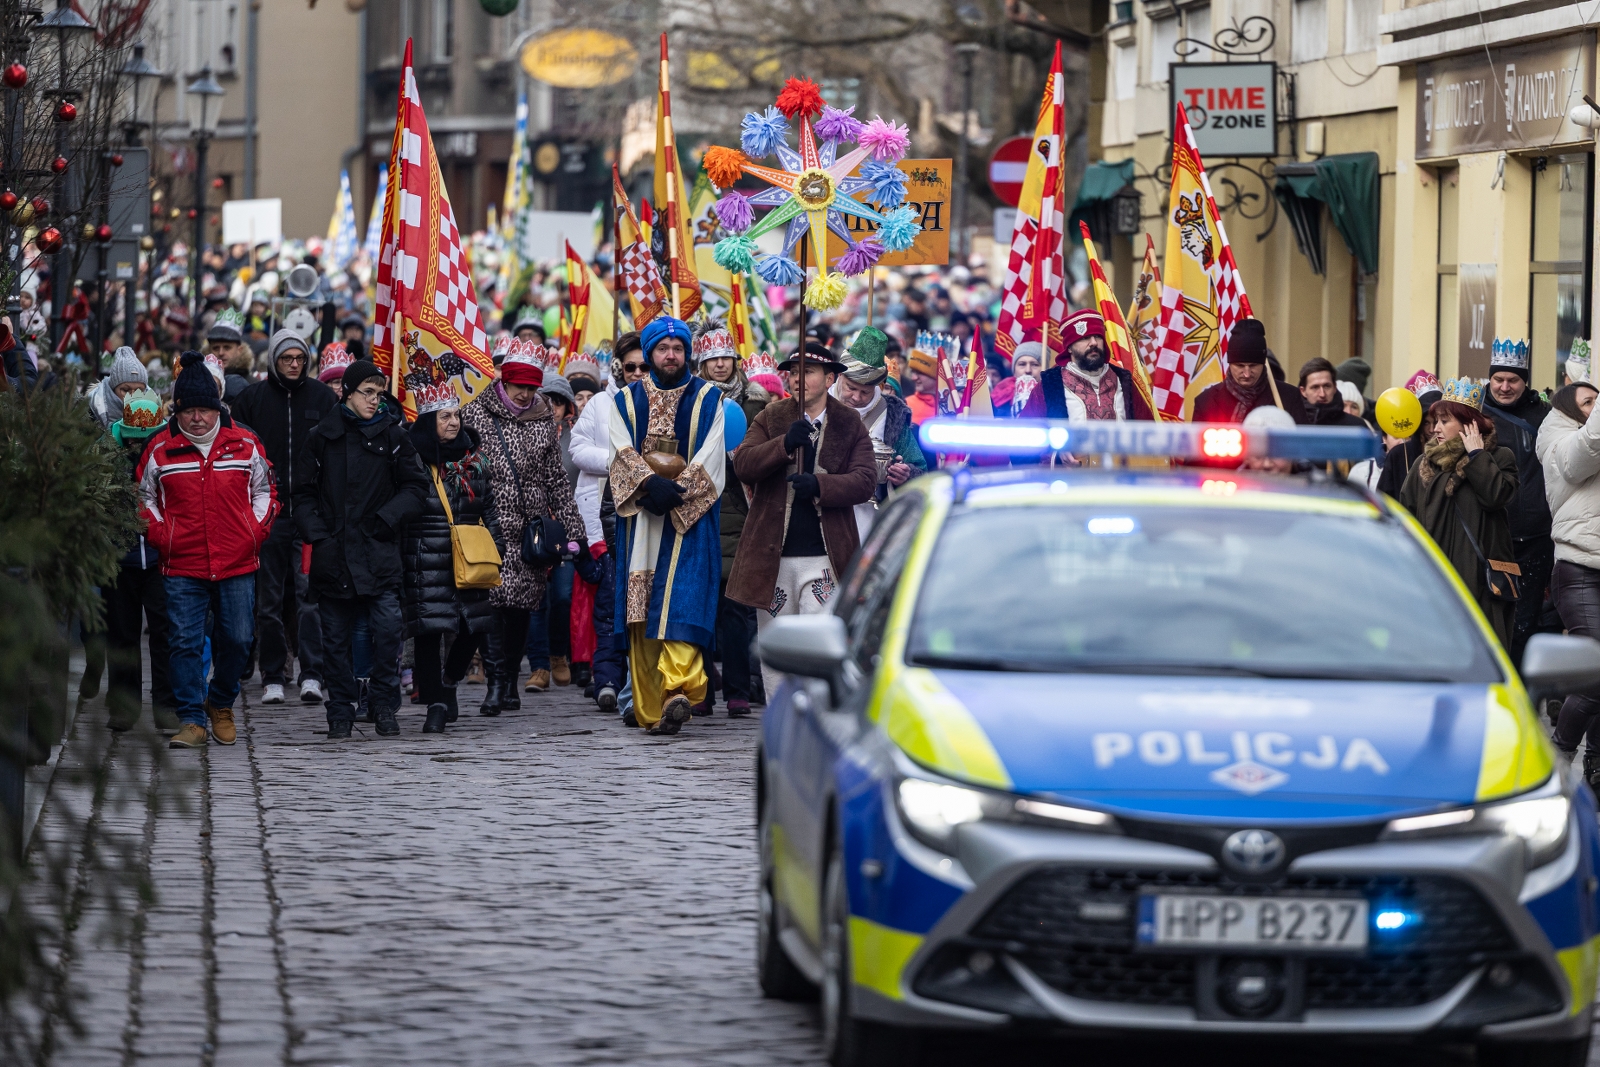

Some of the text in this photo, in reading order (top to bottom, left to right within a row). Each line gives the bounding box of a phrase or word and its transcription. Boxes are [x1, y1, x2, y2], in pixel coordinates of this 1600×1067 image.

[1183, 87, 1266, 112] TIME
[1211, 115, 1266, 129] ZONE
[1092, 730, 1390, 775] POLICJA
[1163, 898, 1359, 941] HPP B237
